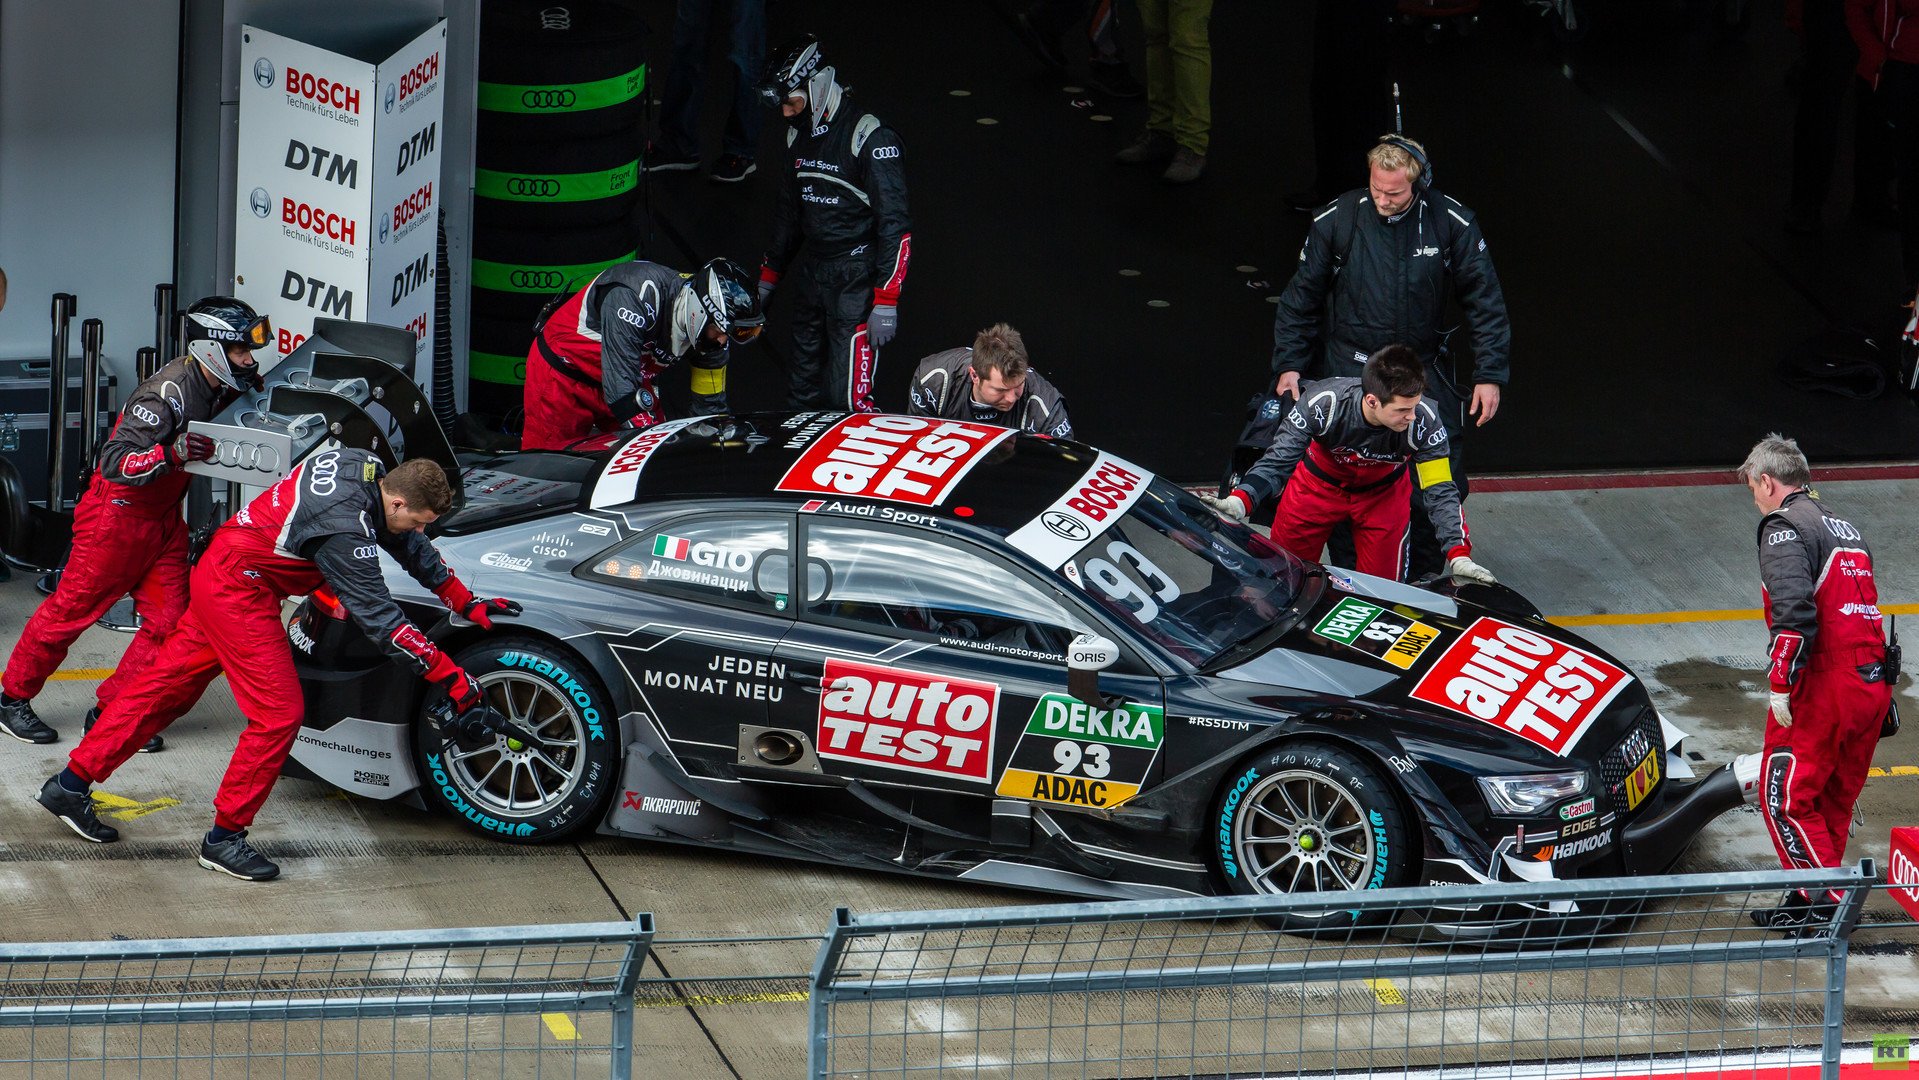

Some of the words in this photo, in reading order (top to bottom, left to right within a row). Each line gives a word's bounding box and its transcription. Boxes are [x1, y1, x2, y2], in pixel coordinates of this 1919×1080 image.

[400, 51, 438, 102] BOSCH
[787, 50, 822, 88] uvex
[286, 66, 360, 115] BOSCH
[286, 94, 316, 114] Technik
[318, 105, 334, 119] fürs
[335, 113, 359, 127] Leben
[285, 139, 358, 189] DTM
[397, 122, 436, 176] DTM
[817, 160, 839, 172] Sport
[610, 170, 630, 182] Front
[610, 180, 625, 191] Left
[282, 197, 355, 245] BOSCH
[394, 181, 432, 232] BOSCH
[282, 224, 312, 244] Technik
[313, 235, 329, 250] fürs
[330, 241, 354, 259] Leben
[280, 269, 353, 320] DTM
[391, 252, 429, 308] DTM
[702, 294, 730, 327] uvex
[208, 329, 244, 341] uvex
[857, 345, 870, 394] Sport
[783, 423, 827, 448] MONAT
[608, 431, 667, 476] BOSCH
[812, 416, 929, 494] auto
[874, 422, 987, 496] TEST
[1066, 461, 1141, 522] BOSCH
[827, 501, 876, 516] Audi
[881, 506, 939, 528] Sport
[480, 552, 533, 571] Eibach
[691, 541, 754, 573] GIO
[648, 560, 750, 592] Джовинацци
[1084, 540, 1181, 624] 93
[1321, 604, 1376, 639] DEKRA
[1363, 621, 1405, 644] 93
[1074, 652, 1106, 662] ORIS
[1393, 631, 1432, 658] ADAC
[1780, 639, 1790, 659] Sport
[708, 655, 786, 679] JEDEN
[1445, 627, 1553, 720] auto
[644, 669, 728, 695] MONAT
[736, 682, 783, 702] NEU
[1504, 650, 1608, 741] TEST
[823, 675, 989, 732] auto
[1044, 700, 1155, 742] DEKRA
[1188, 716, 1249, 731] #RS5DTM
[823, 716, 982, 768] TEST
[1053, 741, 1111, 778] 93
[1032, 775, 1108, 806] ADAC
[1569, 800, 1594, 818] Castrol
[1562, 817, 1597, 837] EDGE
